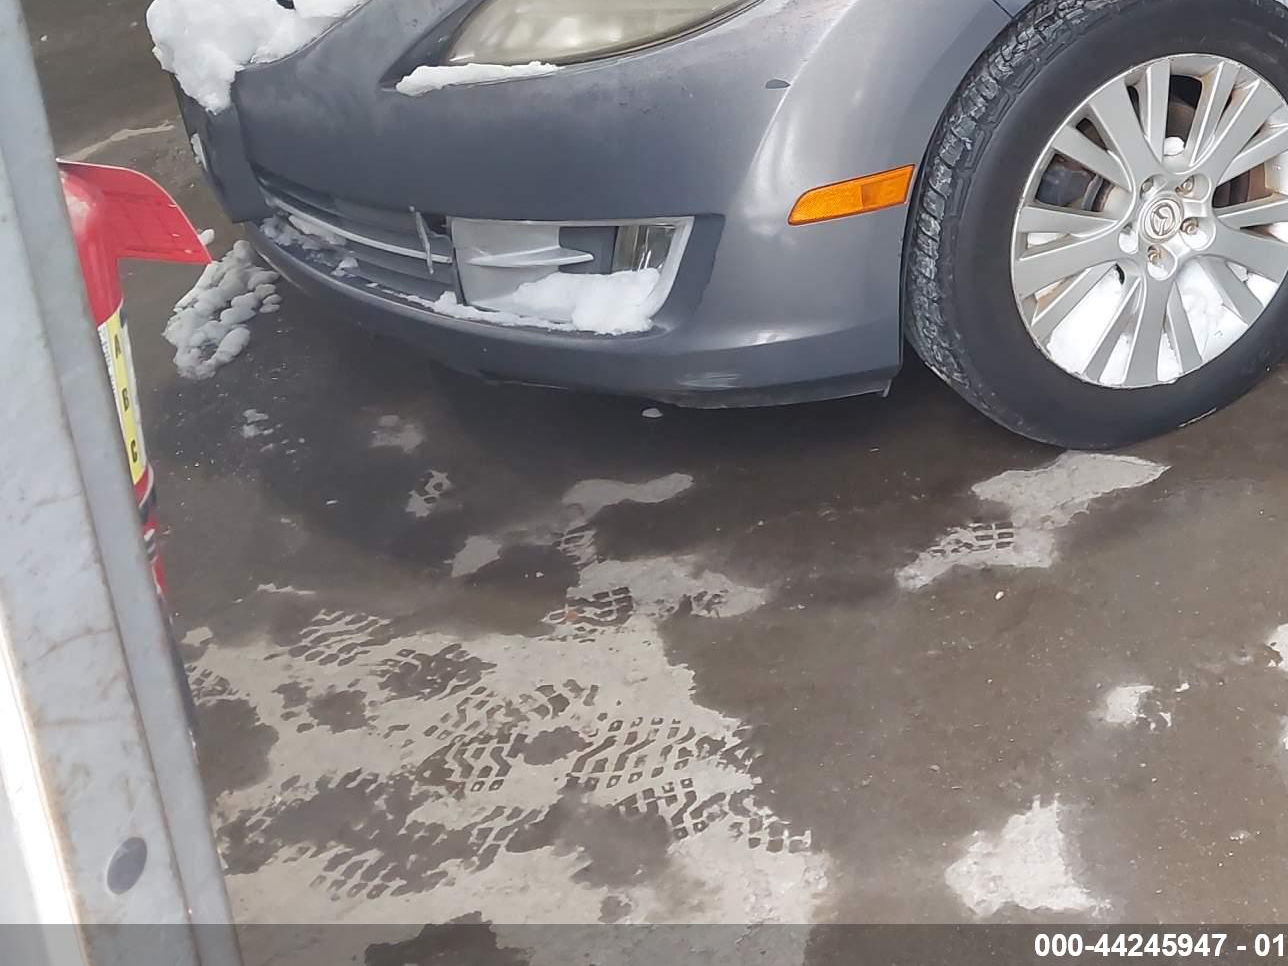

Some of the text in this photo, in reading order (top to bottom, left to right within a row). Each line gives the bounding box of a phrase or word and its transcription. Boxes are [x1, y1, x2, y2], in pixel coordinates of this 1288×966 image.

[114, 334, 122, 359] A
[121, 387, 130, 412] B
[130, 439, 138, 463] C
